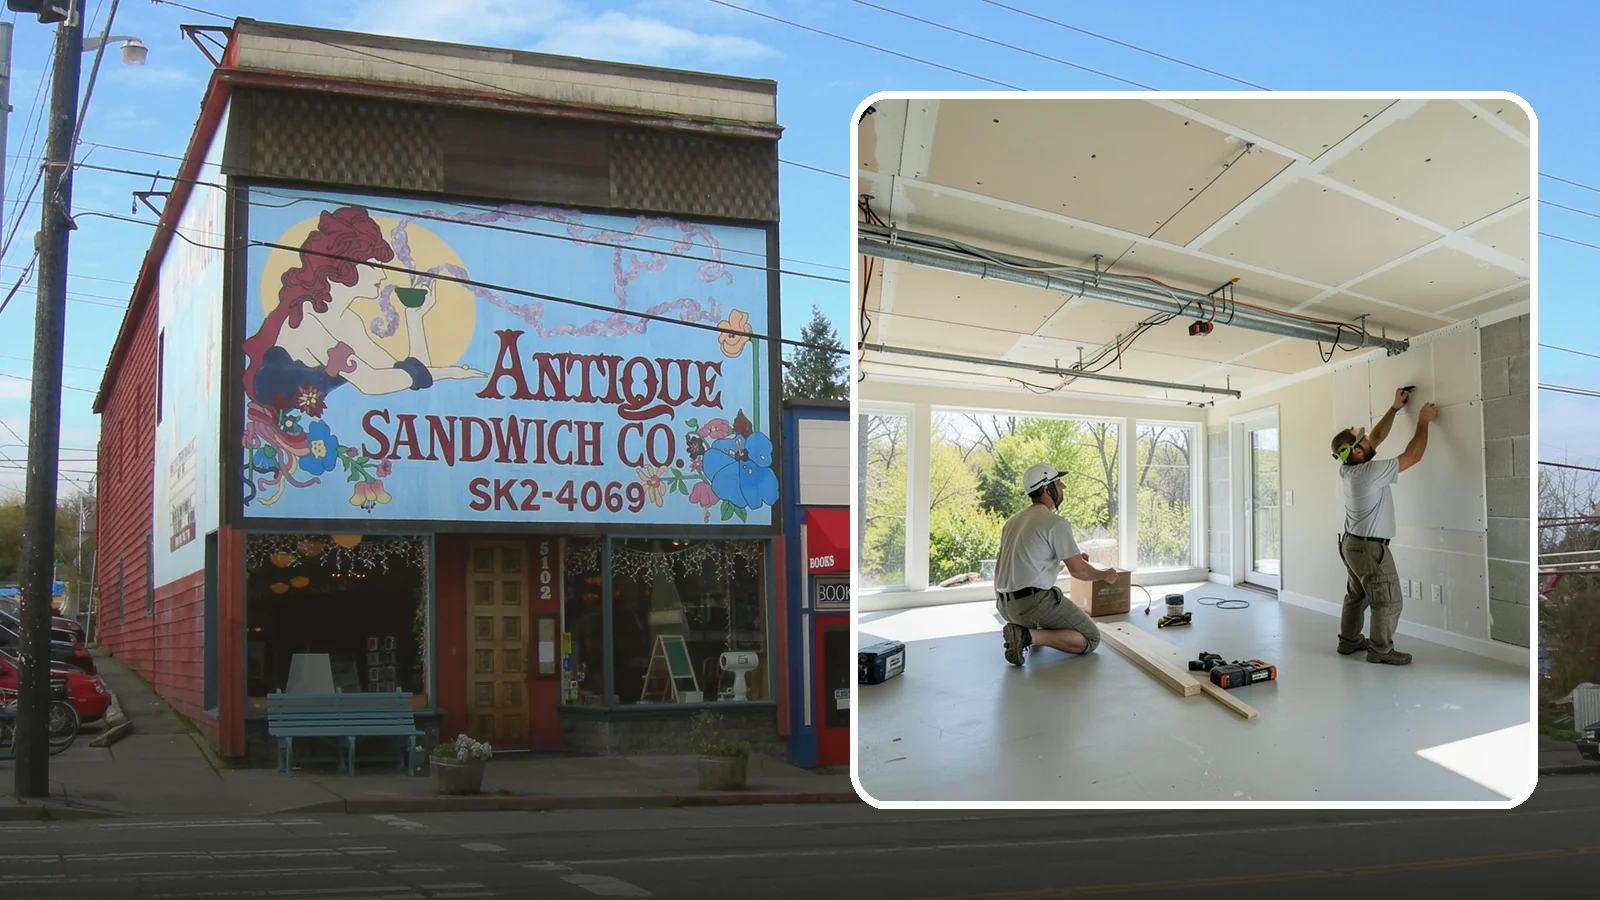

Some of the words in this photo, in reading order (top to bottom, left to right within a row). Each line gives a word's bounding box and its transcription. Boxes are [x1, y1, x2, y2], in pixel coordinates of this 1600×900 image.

[476, 329, 724, 421] ANTIQUE
[361, 409, 604, 467] SANDWICH
[616, 422, 686, 469] CO.
[468, 477, 646, 513] SK2-4069
[540, 541, 552, 600] 5102
[809, 555, 835, 569] BOOKS
